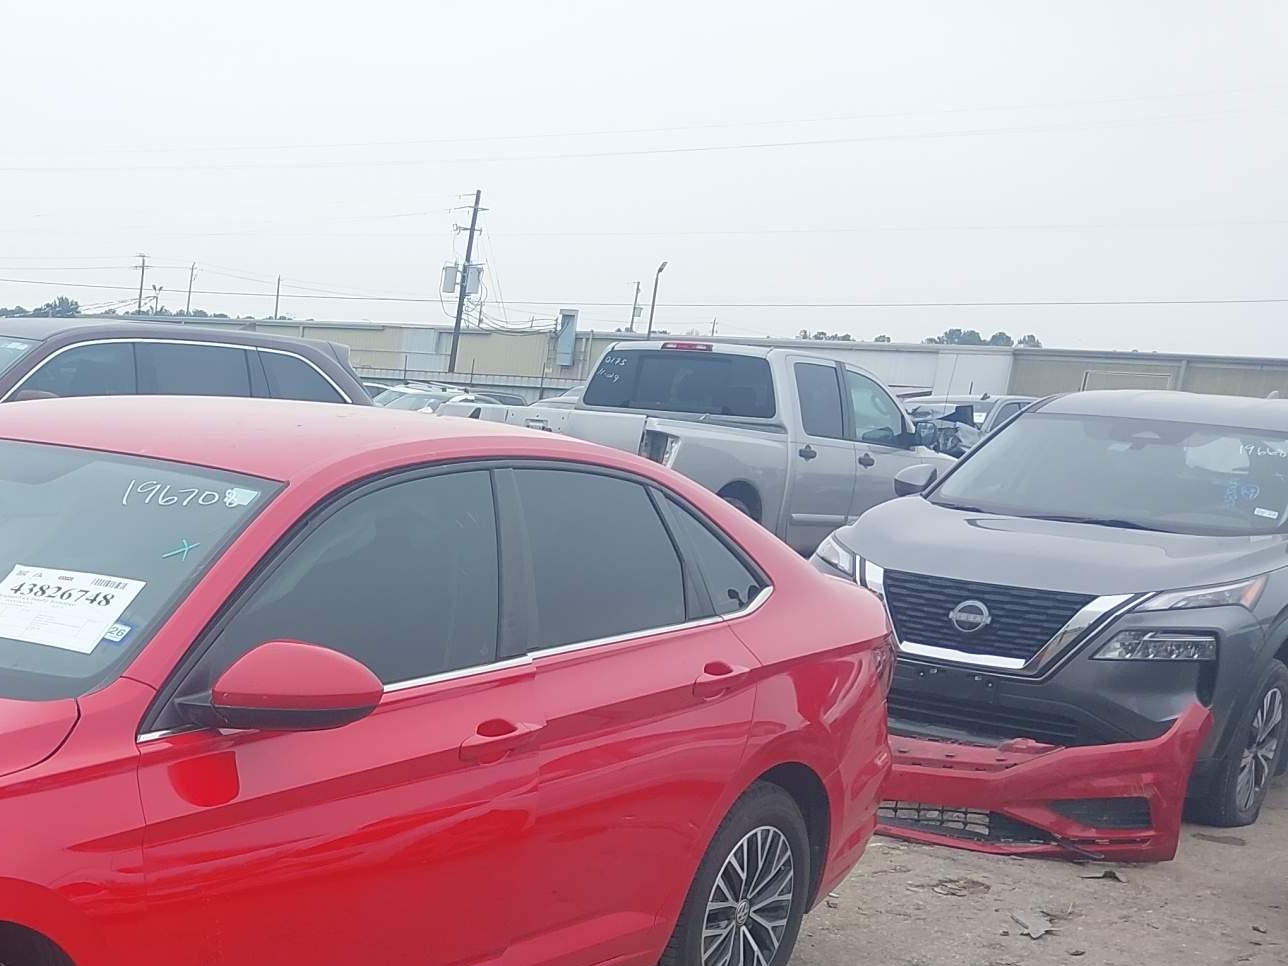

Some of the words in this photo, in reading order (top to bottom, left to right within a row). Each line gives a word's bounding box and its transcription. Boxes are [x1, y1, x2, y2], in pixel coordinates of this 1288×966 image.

[122, 479, 237, 508] 196708
[10, 581, 115, 607] 43826748
[106, 626, 126, 637] 26
